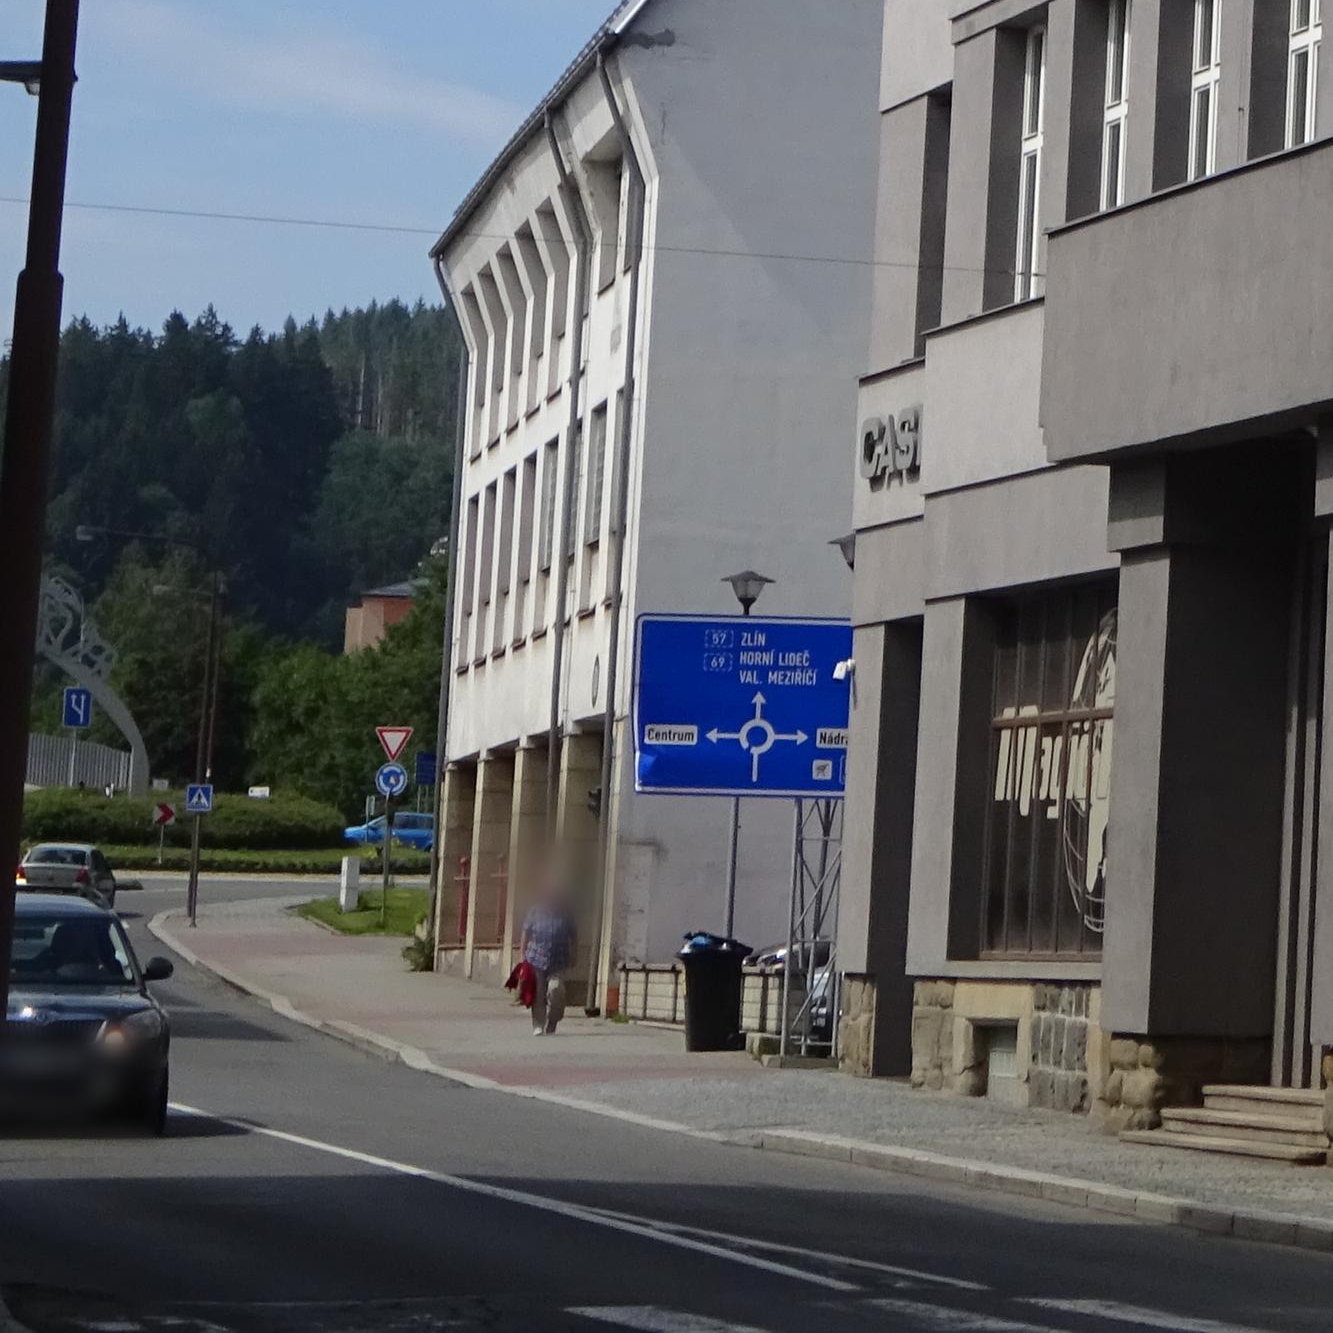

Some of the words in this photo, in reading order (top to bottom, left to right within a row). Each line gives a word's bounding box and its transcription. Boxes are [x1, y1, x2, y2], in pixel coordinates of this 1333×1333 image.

[859, 405, 923, 485] CAS
[741, 631, 766, 647] ZLÍN
[711, 657, 725, 669] 69
[739, 650, 774, 666] HORNÍ
[778, 651, 810, 667] LIDEČ
[739, 671, 763, 685] VAL.
[647, 727, 695, 743] Centrum
[819, 729, 848, 746] Nádr
